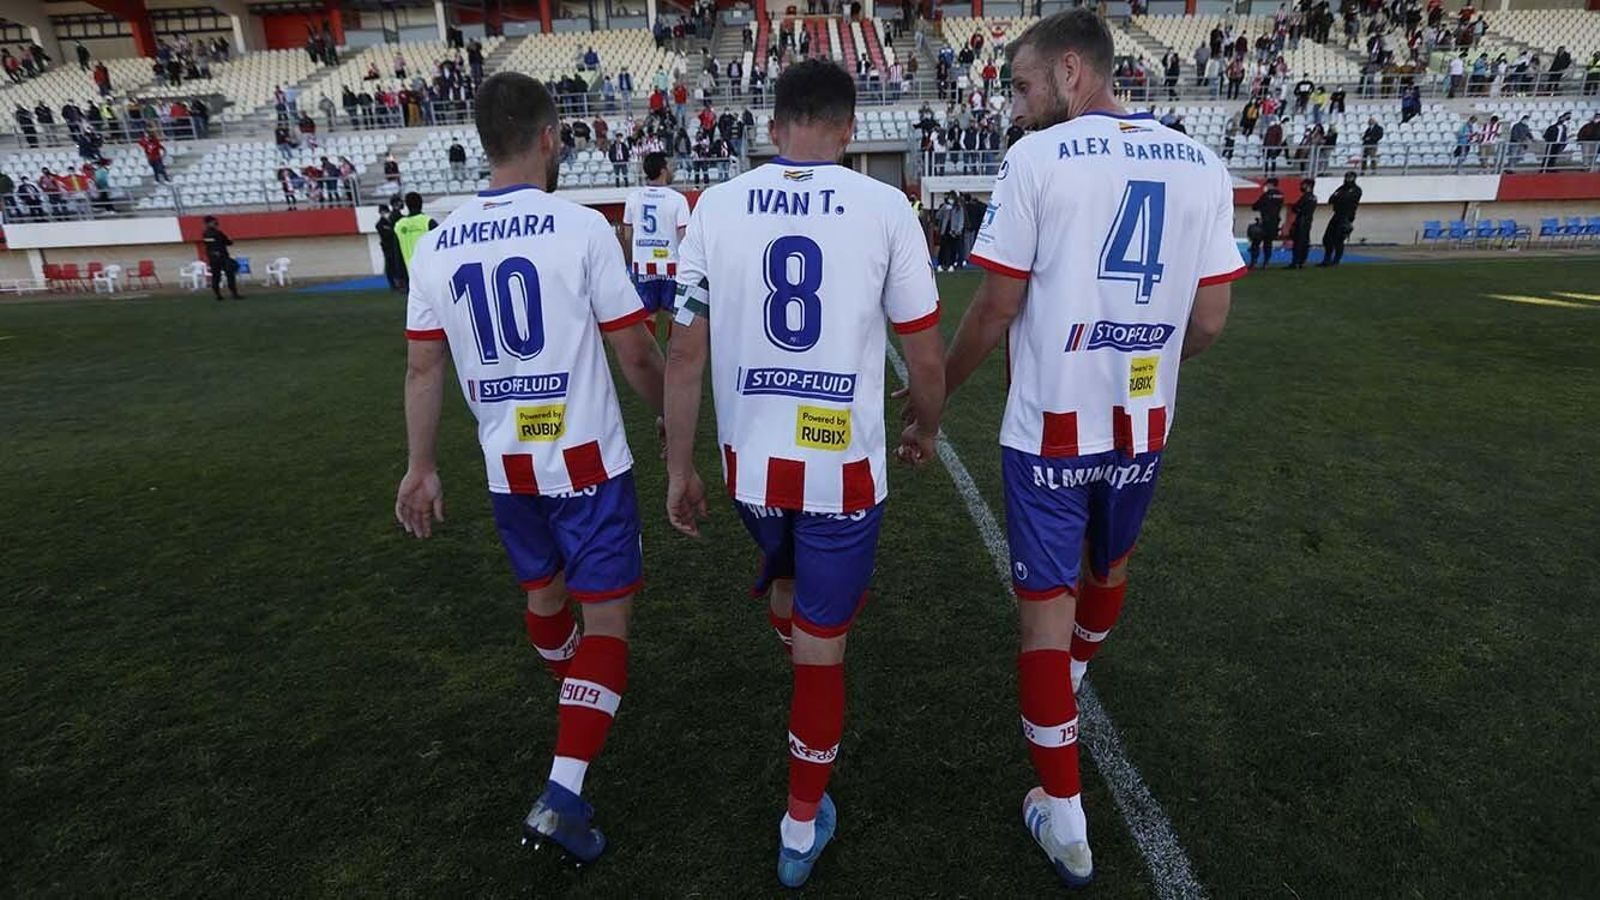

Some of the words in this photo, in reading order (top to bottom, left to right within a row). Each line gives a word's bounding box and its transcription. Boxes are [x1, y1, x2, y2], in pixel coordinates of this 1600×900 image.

[1058, 137, 1111, 160] ALEX
[1123, 141, 1206, 166] BARRERA
[747, 188, 810, 216] IVAN
[819, 189, 845, 215] T.
[435, 214, 555, 251] ALMENARA
[643, 204, 657, 233] 5
[1097, 180, 1166, 304] 4
[763, 235, 823, 352] 8
[449, 256, 545, 365] 10
[752, 371, 852, 393] STOP-FLUID
[520, 411, 551, 421] Powered
[553, 410, 562, 419] by
[521, 422, 562, 437] RUBIX
[803, 412, 834, 425] Powered
[837, 416, 847, 427] by
[802, 426, 846, 445] RUBIX
